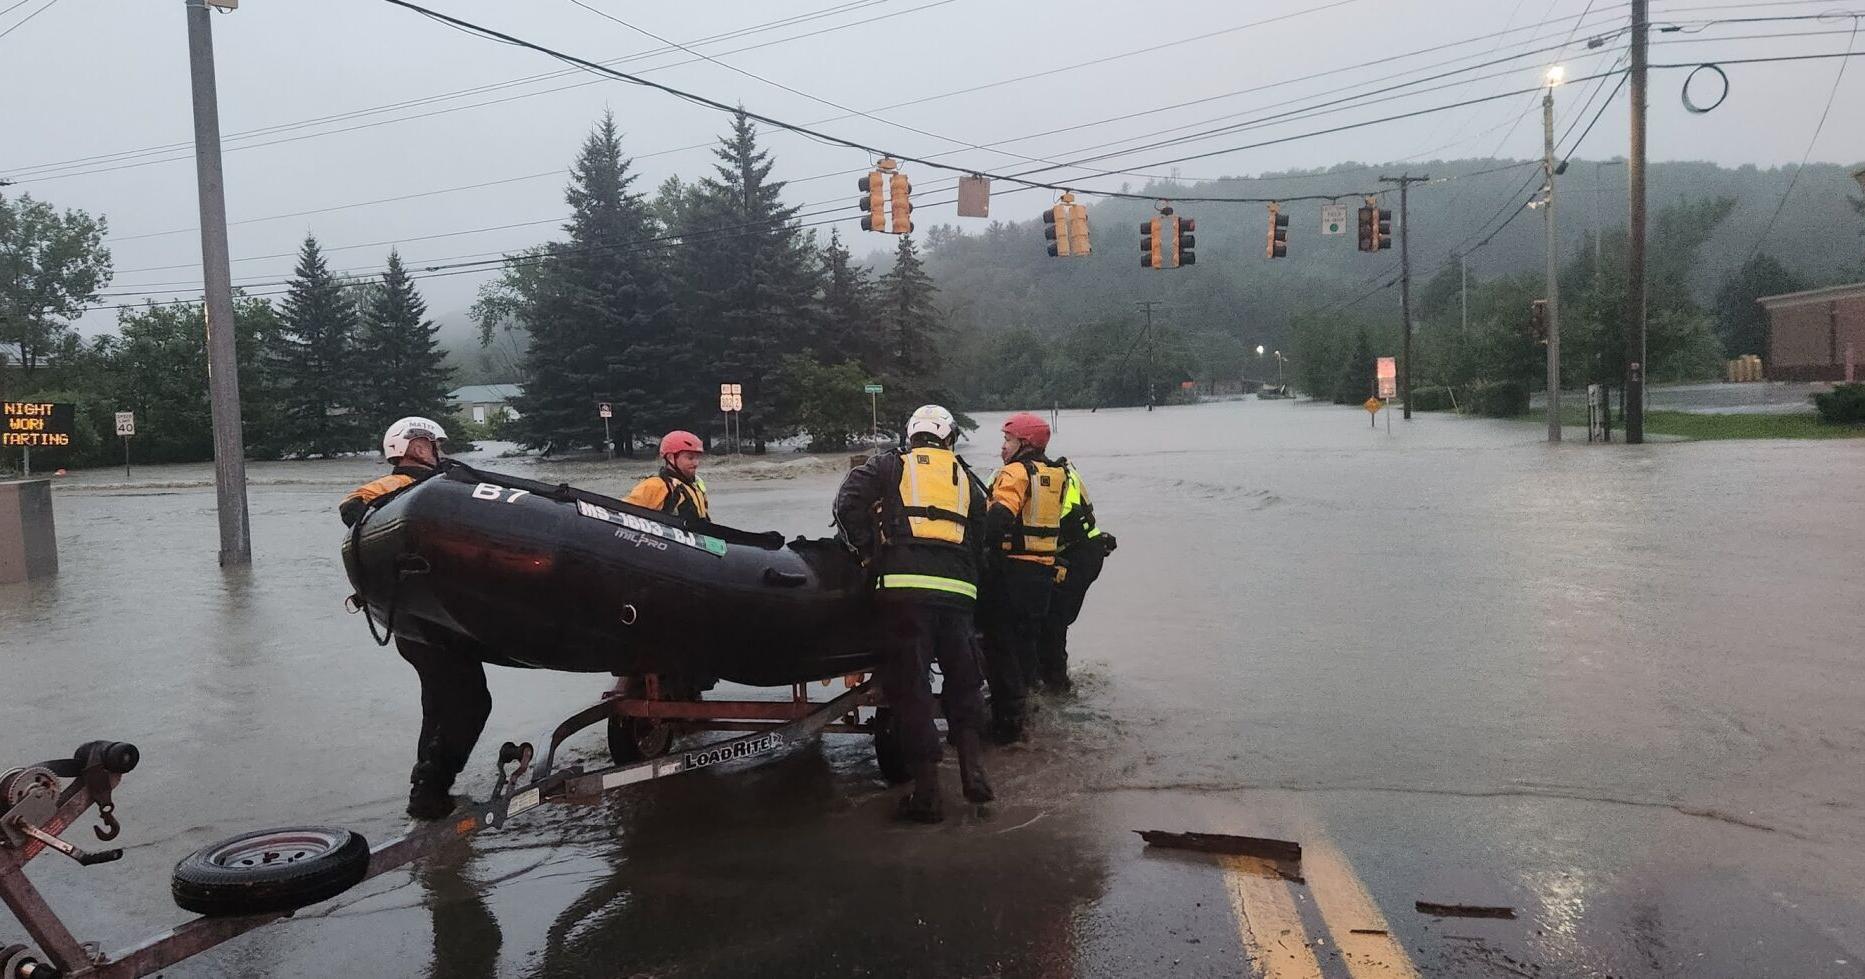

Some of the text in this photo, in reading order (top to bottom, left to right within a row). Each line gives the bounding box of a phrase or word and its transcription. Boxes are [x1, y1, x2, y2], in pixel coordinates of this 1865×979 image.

[4, 402, 54, 416] NIGHT
[118, 423, 133, 432] 40
[580, 500, 610, 521] MS
